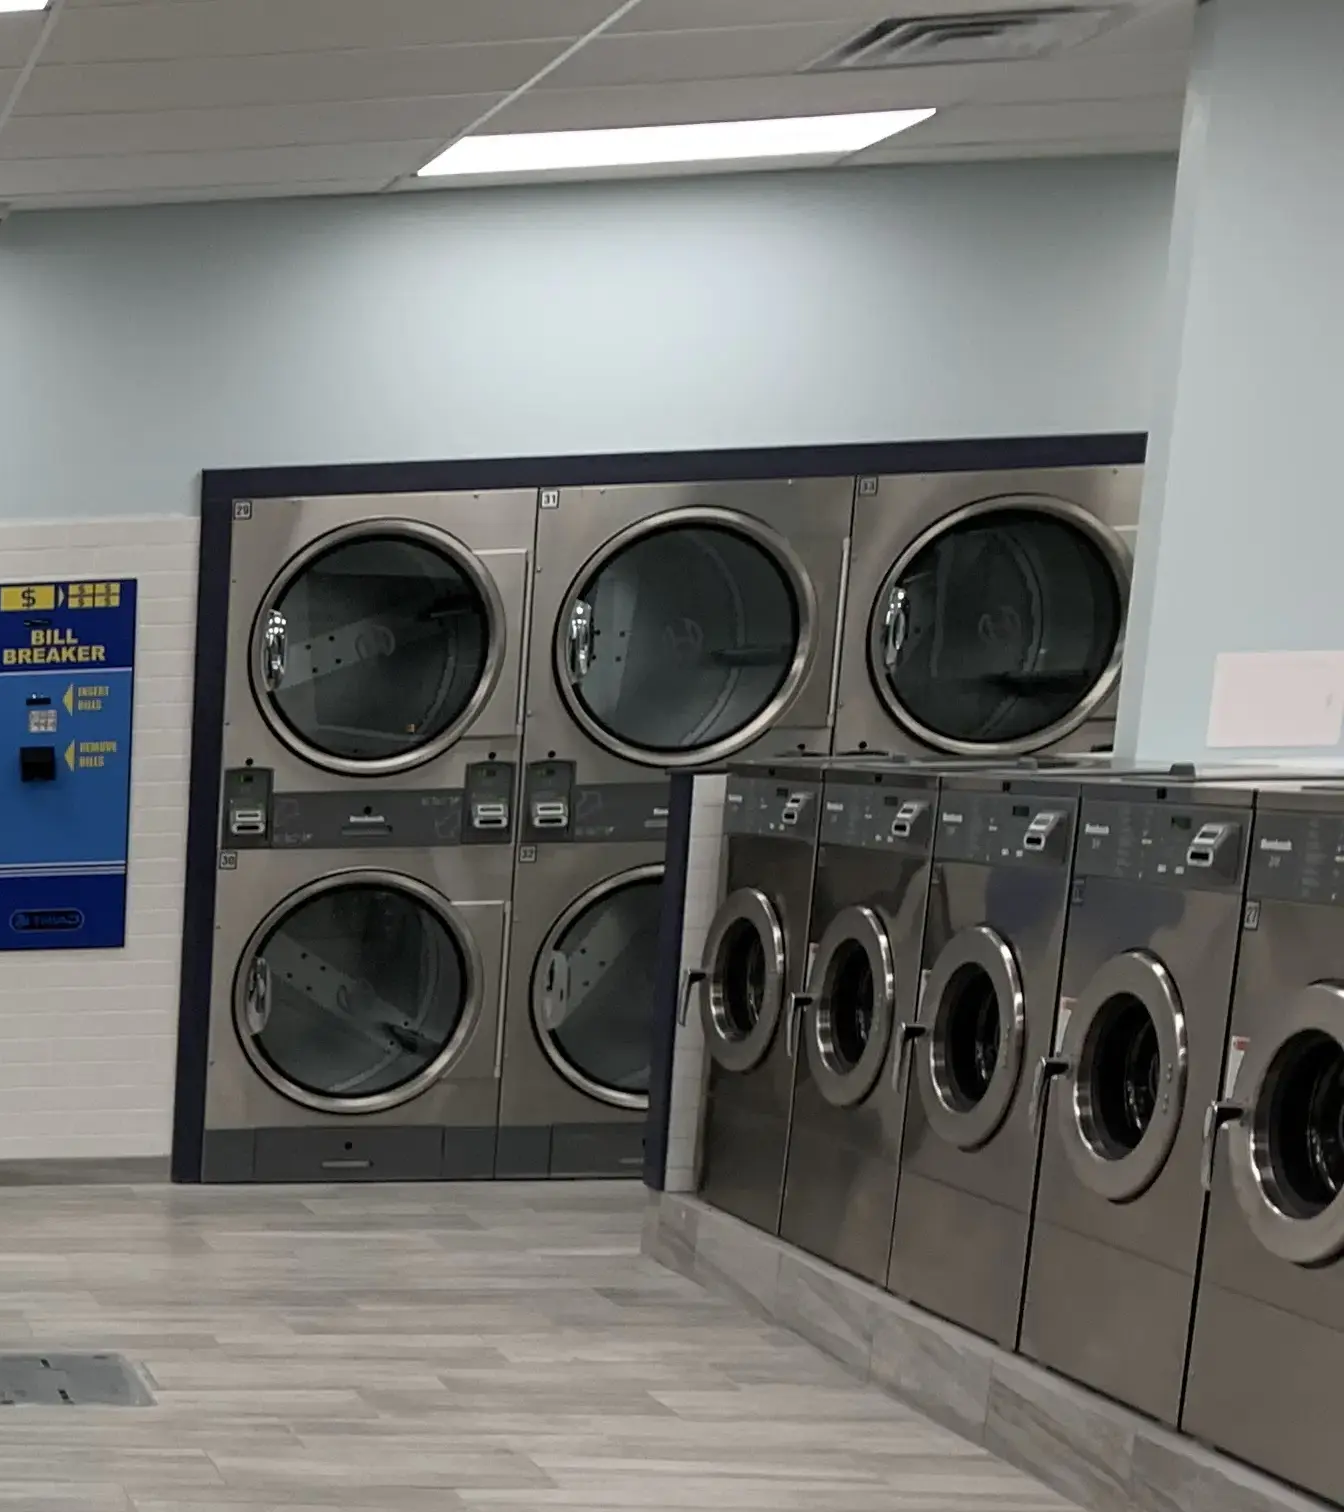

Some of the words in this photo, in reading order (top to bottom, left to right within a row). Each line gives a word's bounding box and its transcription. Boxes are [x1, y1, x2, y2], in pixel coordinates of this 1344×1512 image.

[544, 494, 556, 505] 31
[236, 504, 249, 516] 29
[21, 587, 36, 608] $
[31, 628, 79, 646] BILL
[2, 645, 107, 665] BREAKER
